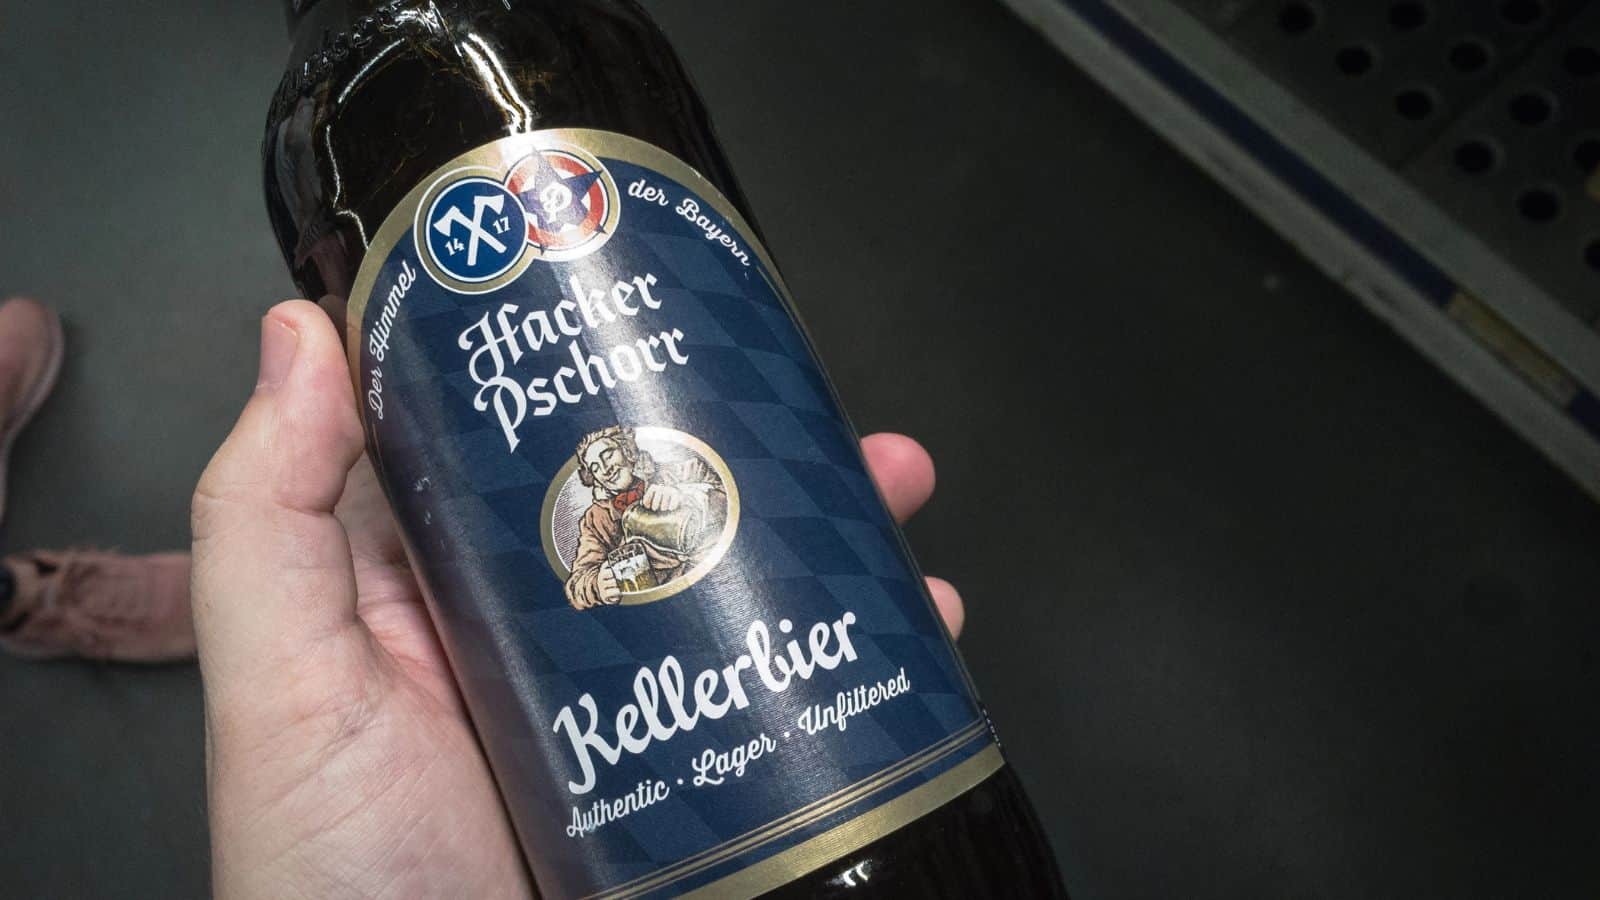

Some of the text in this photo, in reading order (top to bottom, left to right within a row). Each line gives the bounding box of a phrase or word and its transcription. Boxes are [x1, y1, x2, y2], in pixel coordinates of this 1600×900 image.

[445, 238, 465, 256] 14
[493, 215, 511, 234] 17
[628, 179, 750, 266] der Bayern
[368, 259, 416, 420] Der Himmel
[458, 272, 662, 383] Hacker
[473, 327, 689, 453] Pschorr
[554, 611, 857, 794] Kellerbier
[566, 668, 911, 838] Authentic Lager Unfiltered
